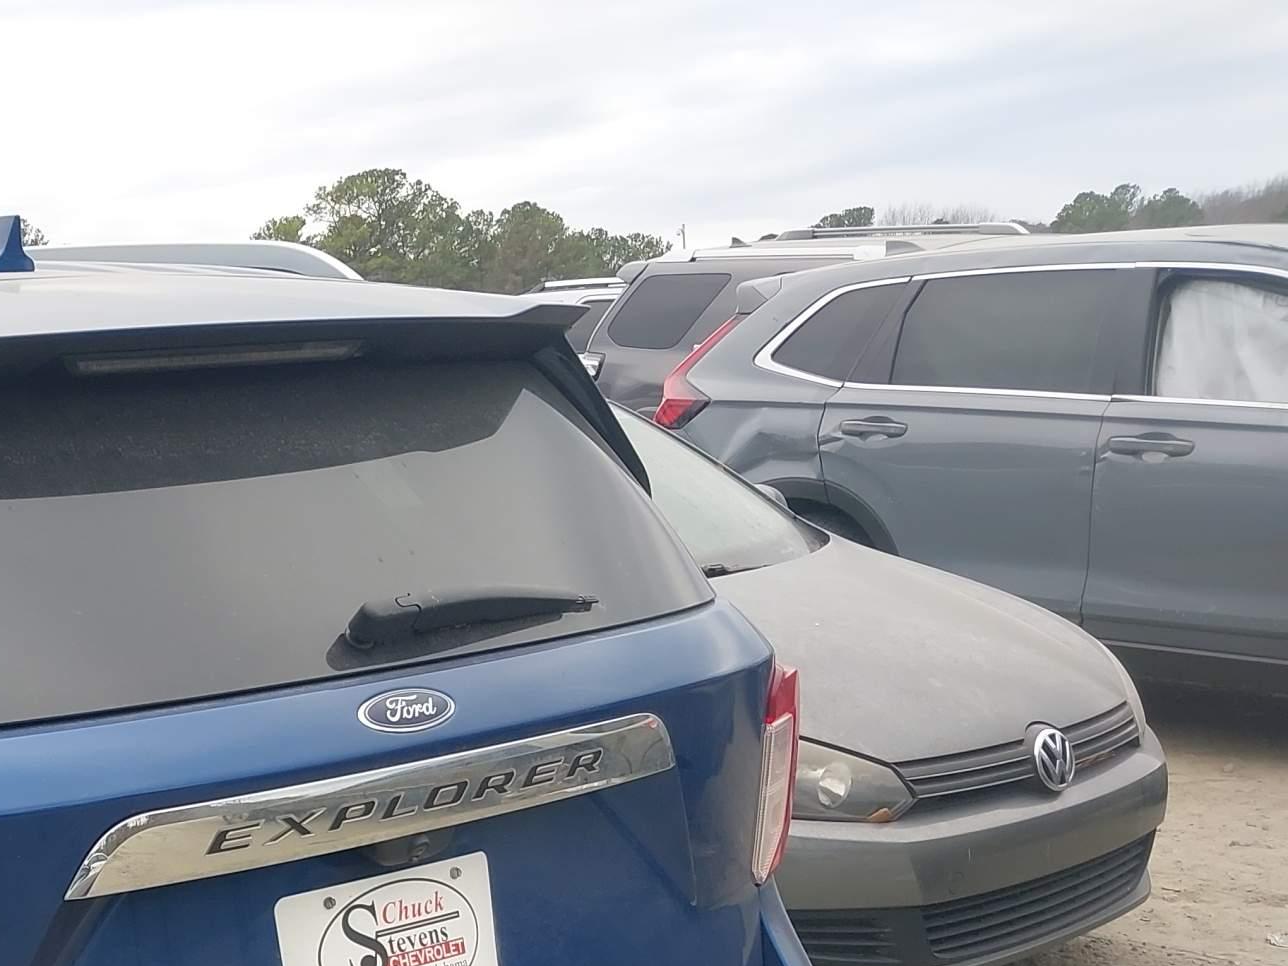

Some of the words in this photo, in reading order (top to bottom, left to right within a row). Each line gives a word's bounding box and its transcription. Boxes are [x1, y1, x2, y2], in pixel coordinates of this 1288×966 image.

[385, 695, 437, 721] Ford
[206, 748, 604, 855] EXPLORER
[382, 891, 444, 924] Chuck
